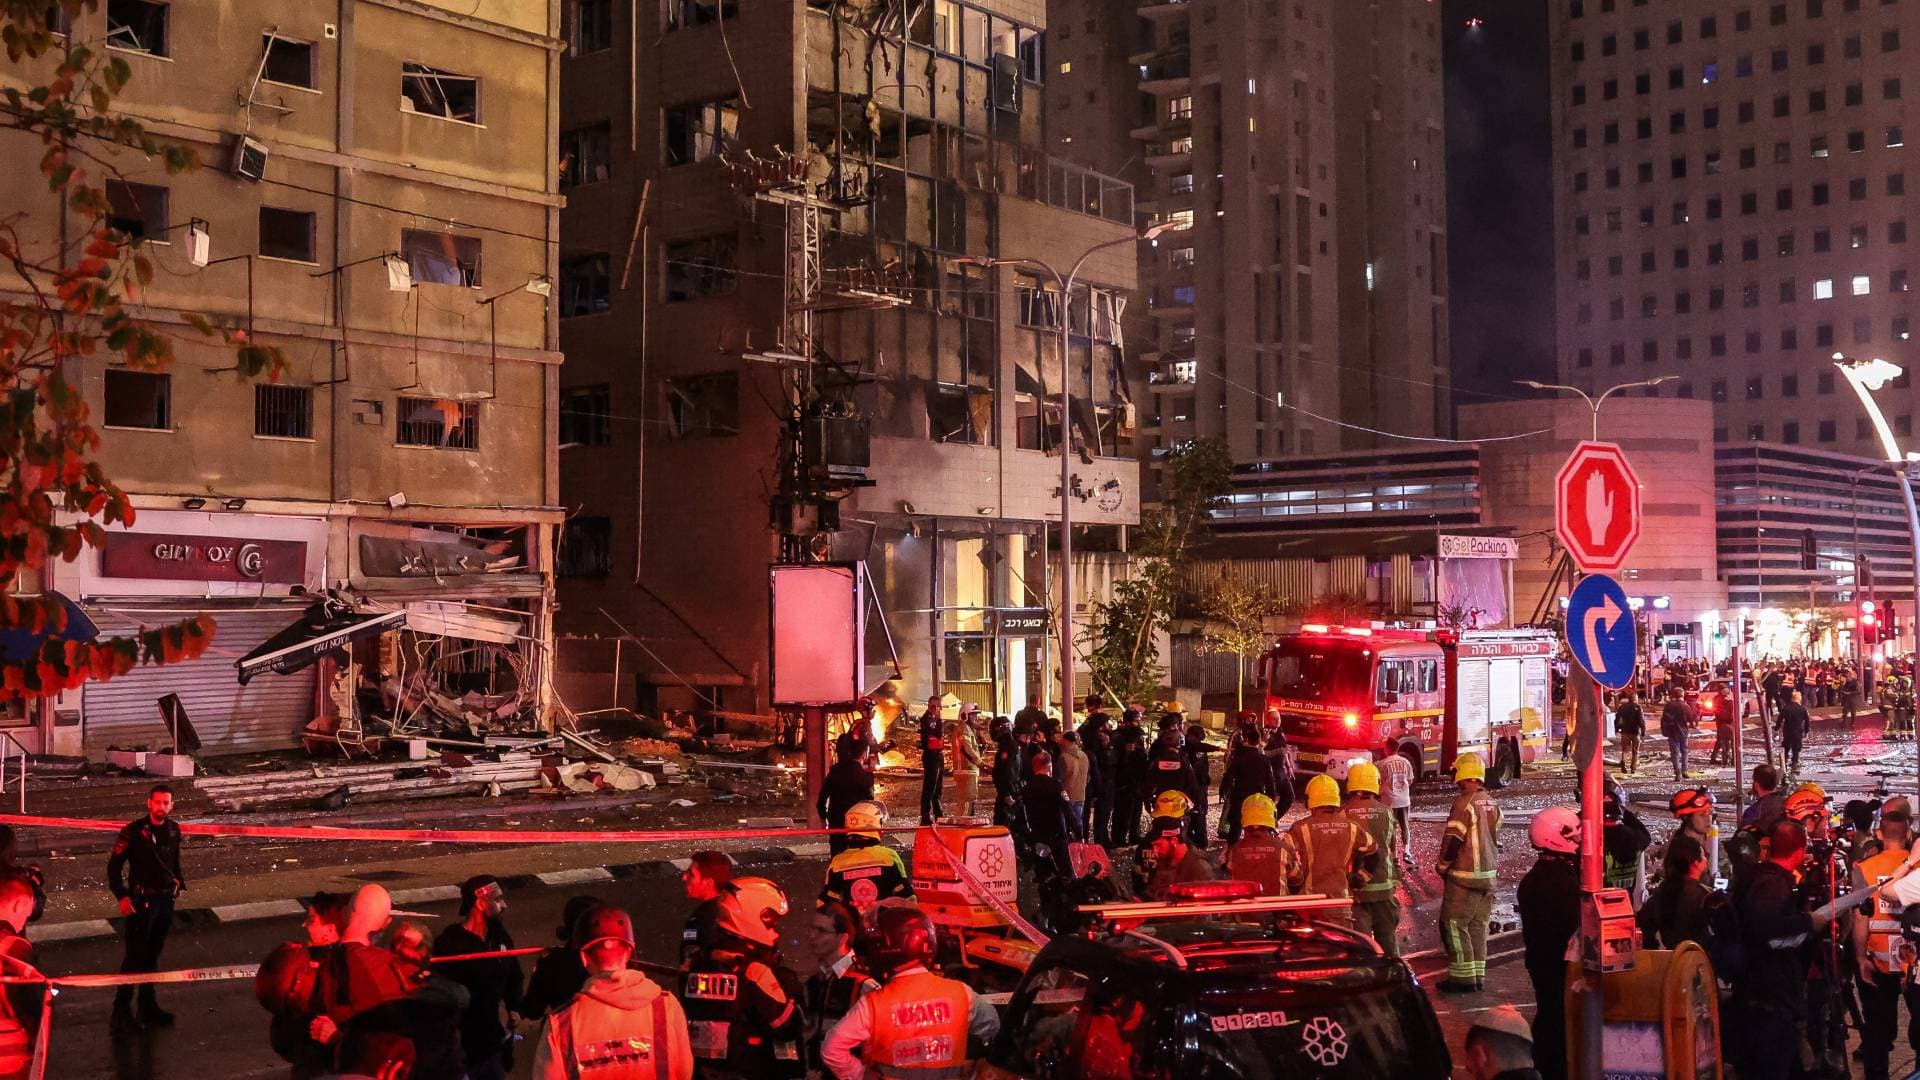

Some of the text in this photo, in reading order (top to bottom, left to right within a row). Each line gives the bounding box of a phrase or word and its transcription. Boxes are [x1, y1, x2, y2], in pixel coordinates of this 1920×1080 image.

[1005, 619, 1021, 628] רכב
[1471, 645, 1501, 655] והצלה
[1421, 729, 1432, 740] 102
[1230, 1012, 1284, 1028] 1221
